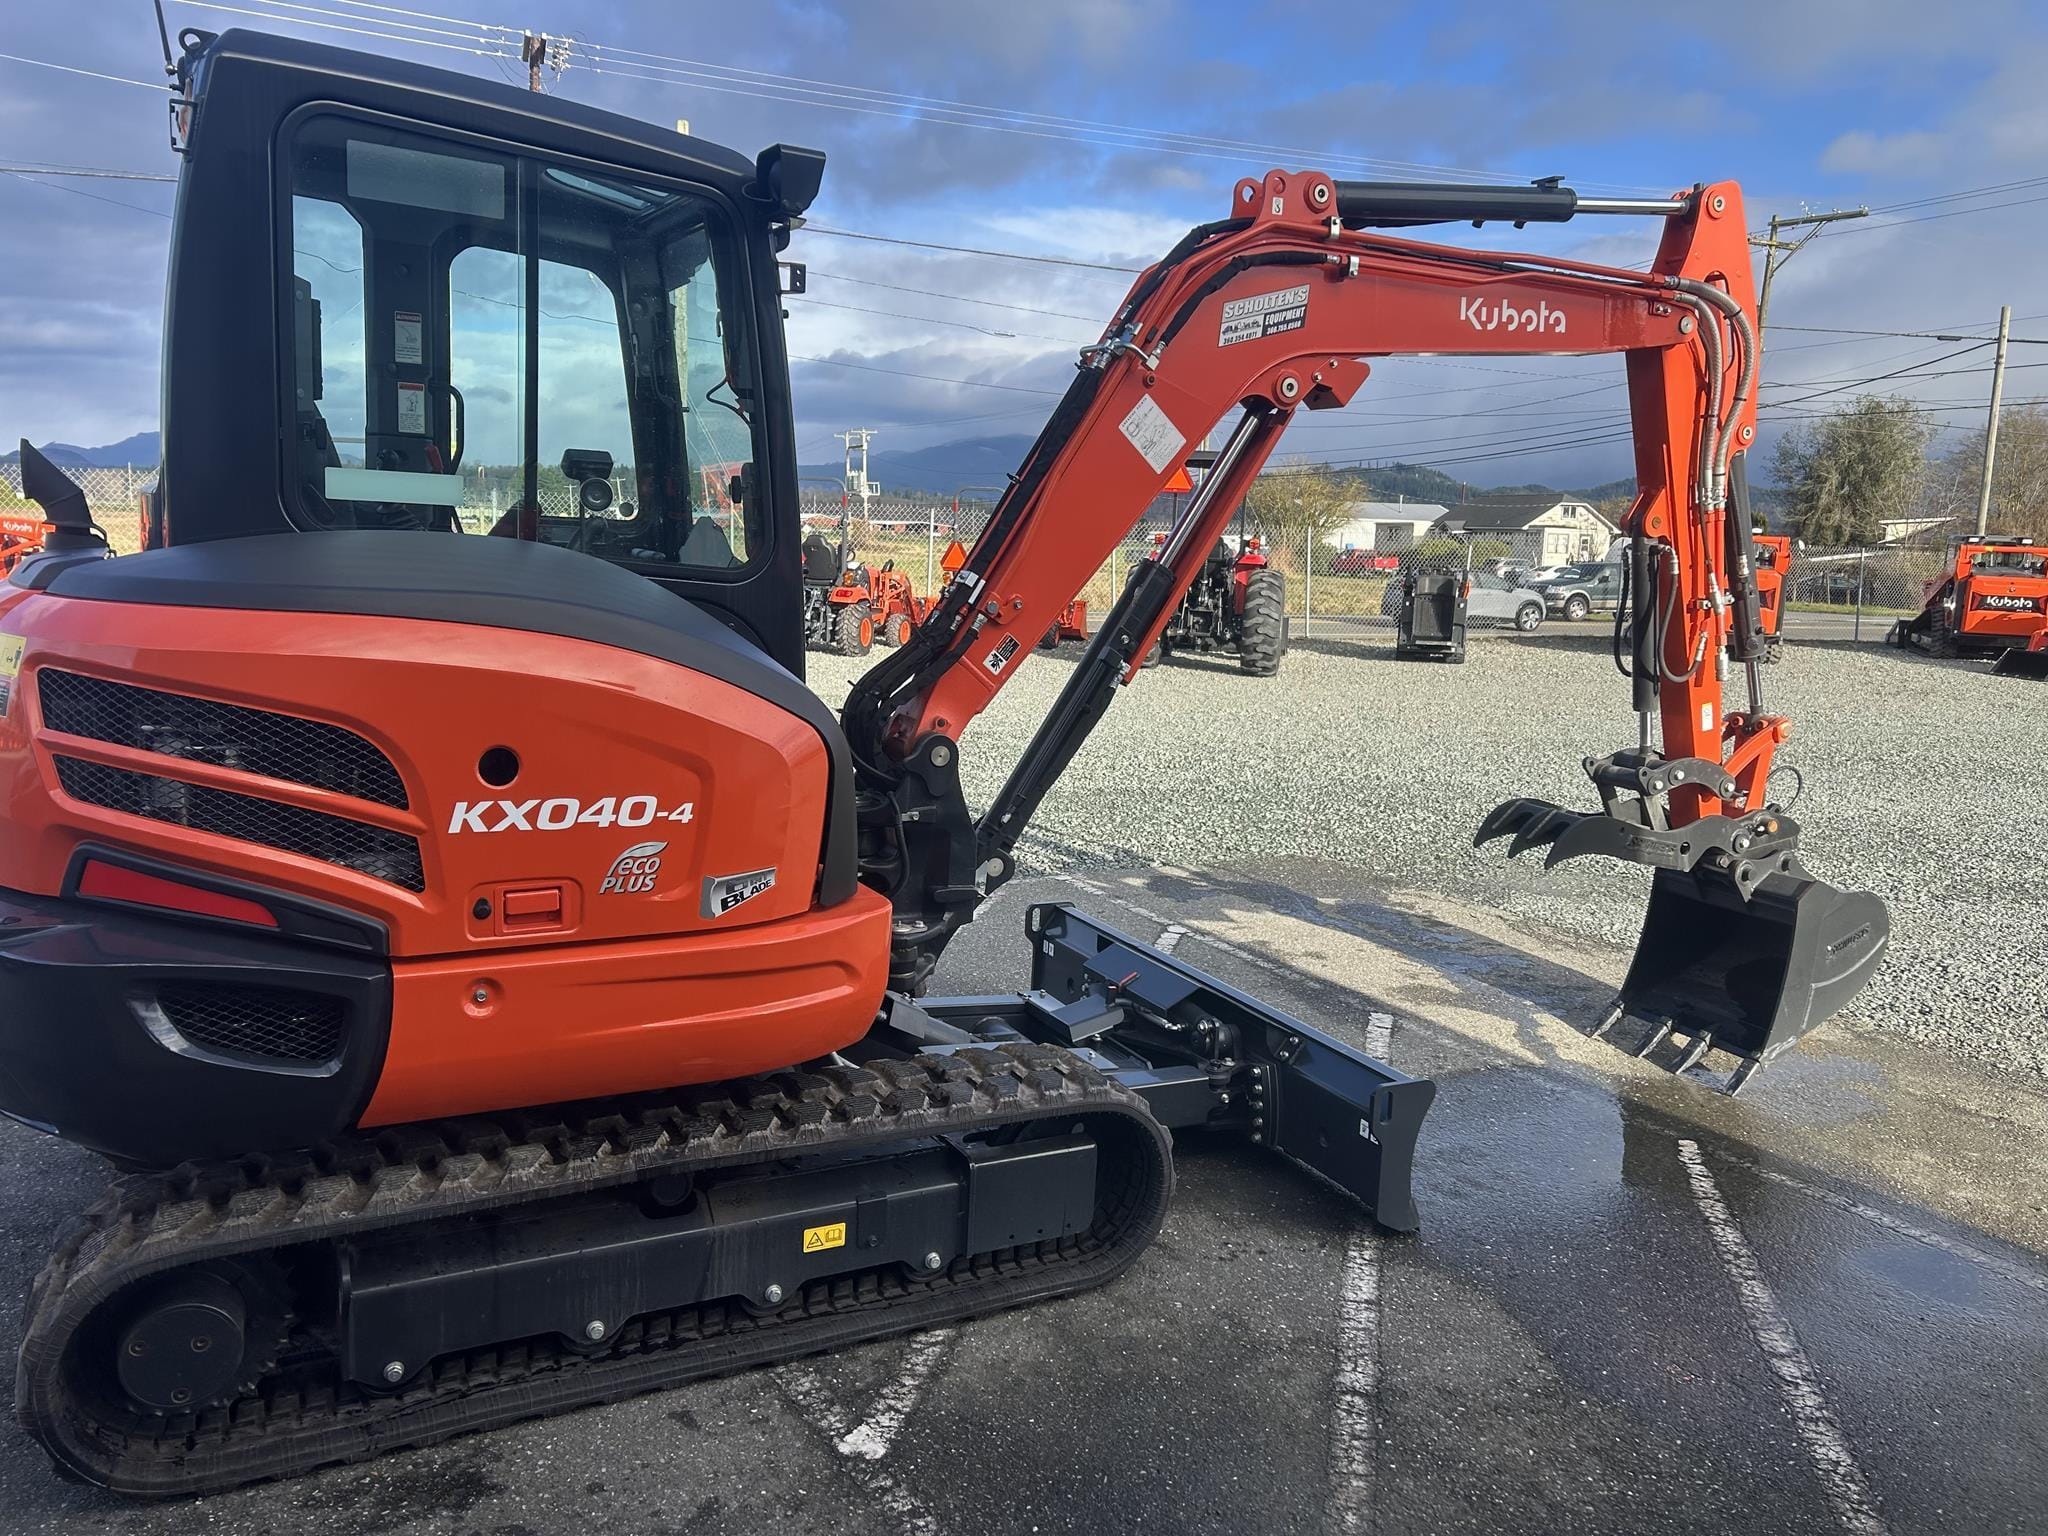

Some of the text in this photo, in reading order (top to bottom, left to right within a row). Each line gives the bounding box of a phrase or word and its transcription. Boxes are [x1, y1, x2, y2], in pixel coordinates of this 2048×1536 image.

[1225, 288, 1307, 318] SCHOLTEN'S
[1265, 307, 1306, 325] EQUIPMENT
[1460, 296, 1566, 333] Kubota
[1986, 596, 2033, 607] Kubota
[447, 795, 694, 834] KX040-4
[599, 873, 658, 895] PLUS
[720, 878, 774, 913] BLADE
